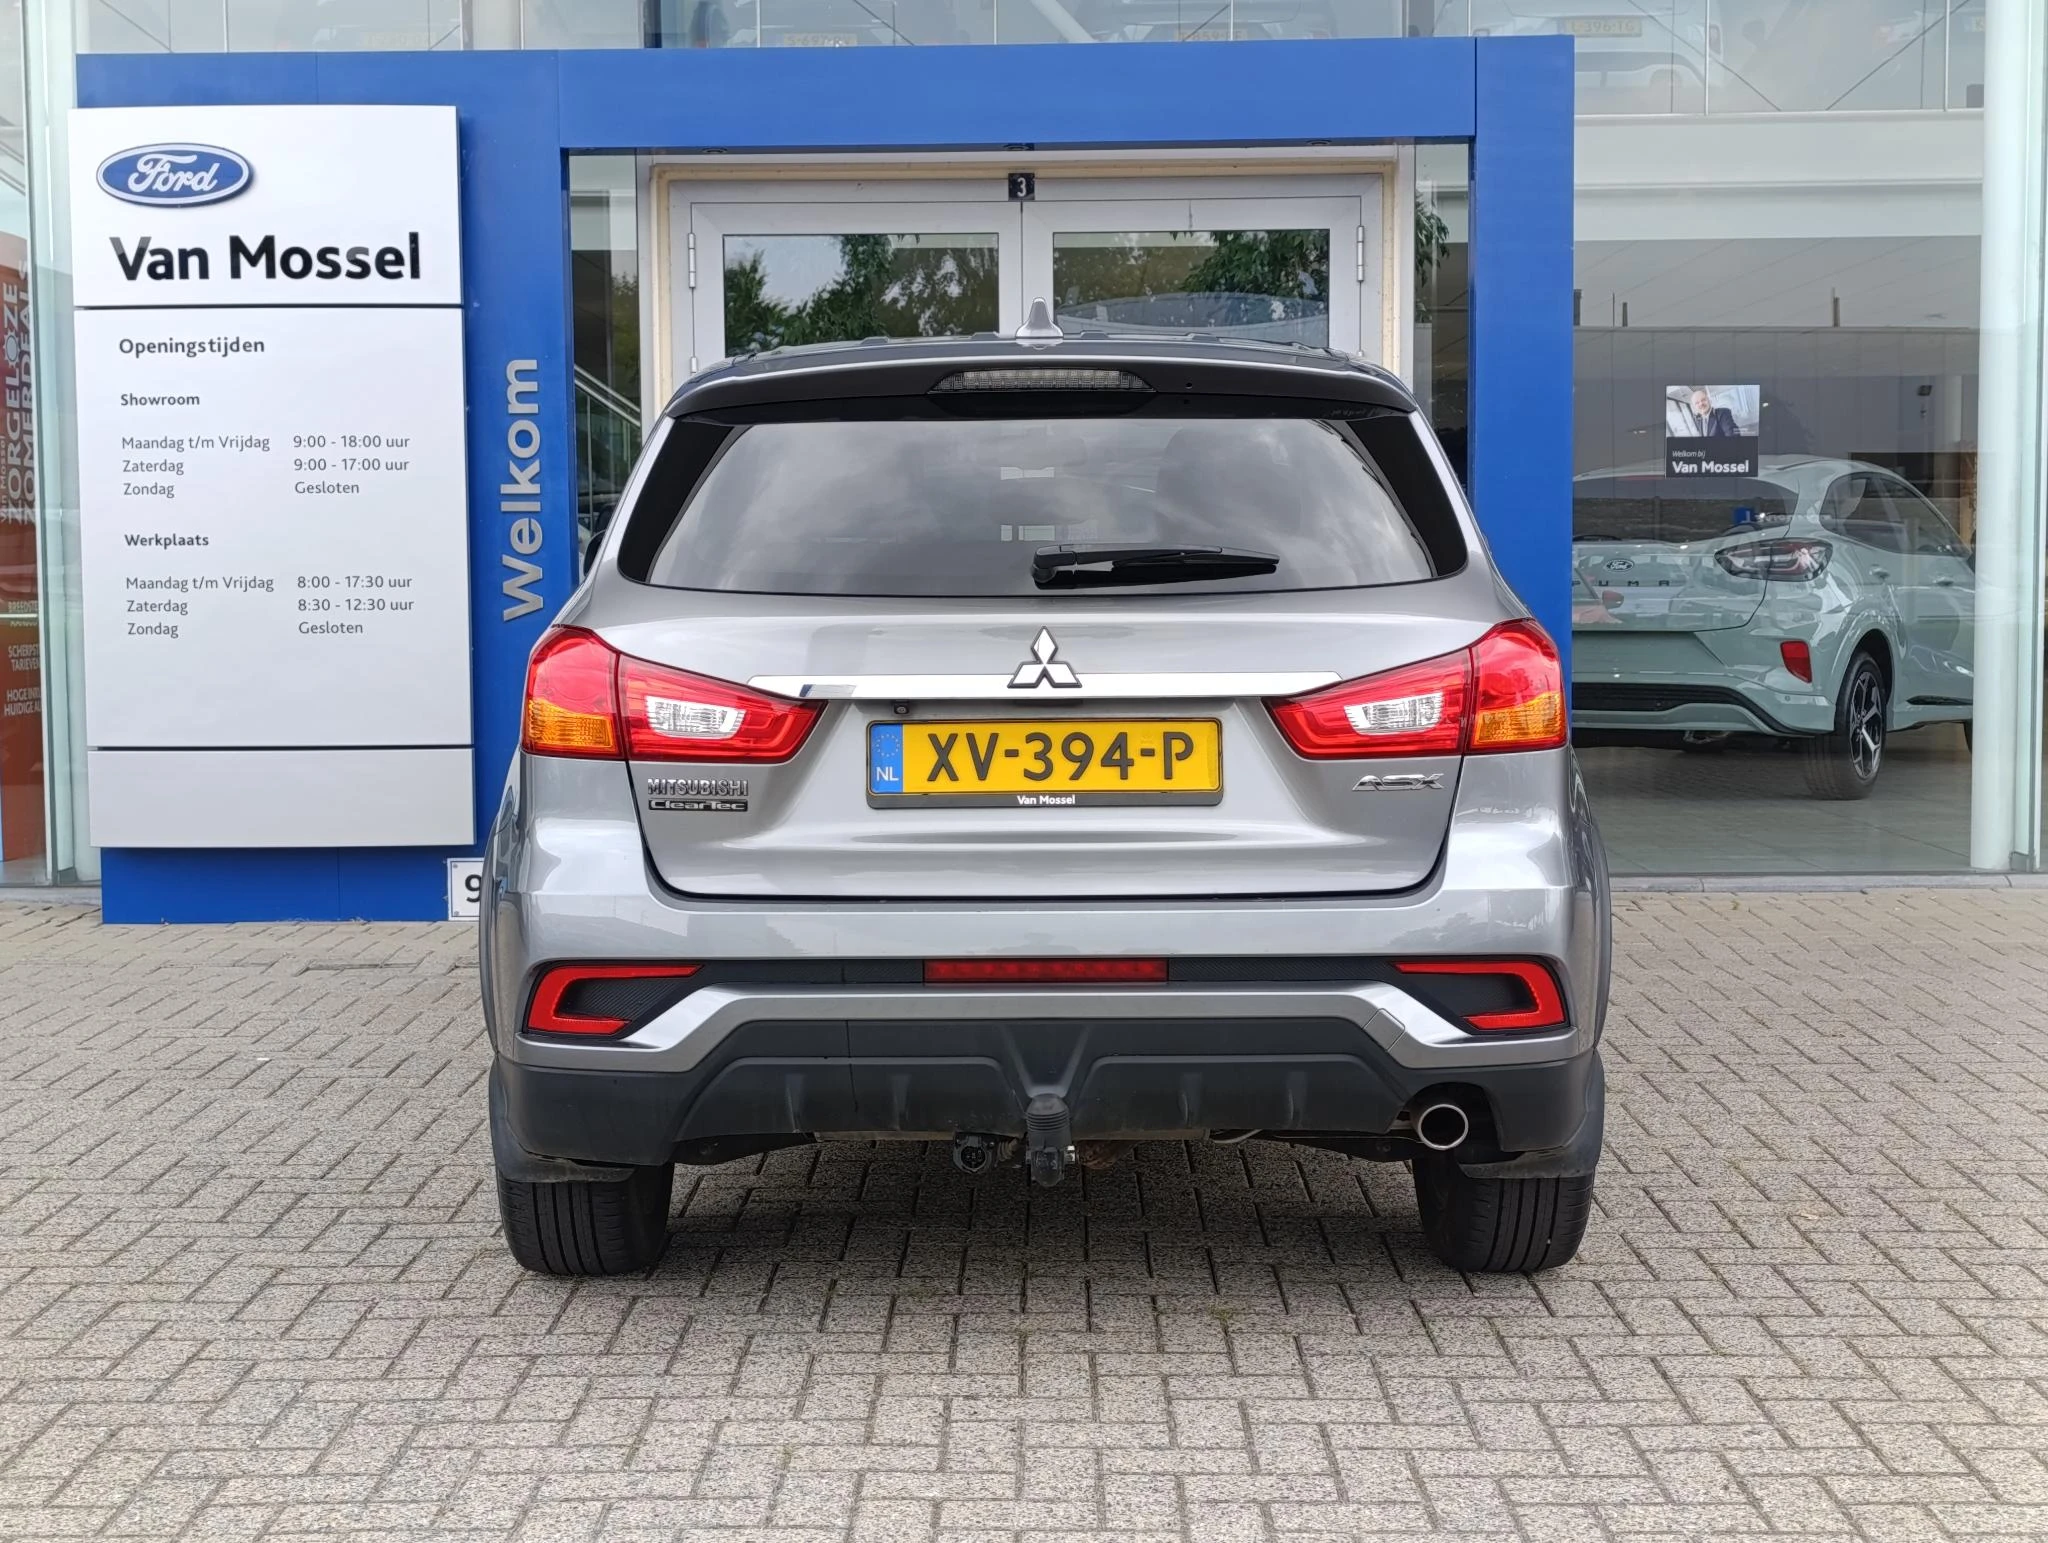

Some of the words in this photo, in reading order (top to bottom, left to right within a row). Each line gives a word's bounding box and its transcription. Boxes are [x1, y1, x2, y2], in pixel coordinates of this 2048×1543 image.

[128, 152, 219, 193] Ford
[1017, 177, 1027, 197] 3
[110, 236, 209, 281] Van
[229, 231, 421, 280] Mossel
[118, 335, 266, 359] Openingstijden
[120, 392, 201, 407] Showroom
[121, 435, 185, 453] Maandag
[188, 435, 215, 449] t/m
[218, 434, 271, 453] Vrijdag
[292, 434, 327, 448] 9:00
[340, 434, 382, 448] 18:00
[385, 438, 411, 448] uur
[1672, 450, 1697, 458] Welkom
[122, 458, 185, 476] Zaterdag
[293, 458, 327, 472] 9:00
[341, 457, 381, 471] 17:00
[385, 461, 410, 471] uur
[1672, 460, 1698, 473] Van
[1701, 459, 1749, 473] Mossel
[123, 481, 175, 499] Zondag
[294, 480, 360, 494] Gesloten
[500, 359, 544, 621] Welkom
[123, 532, 210, 551] Werkplaats
[126, 575, 189, 594] Maandag
[191, 575, 219, 590] t/m
[222, 575, 275, 593] Vrijdag
[297, 575, 331, 589] 8:00
[344, 575, 384, 589] 17:30
[388, 578, 413, 588] uur
[126, 599, 189, 616] Zaterdag
[297, 598, 331, 612] 8:30
[344, 598, 386, 611] 12:30
[390, 601, 415, 611] uur
[127, 621, 179, 640] Zondag
[298, 620, 364, 635] Gesloten
[926, 731, 1195, 782] XV-394-P
[876, 767, 899, 782] NL
[1352, 773, 1444, 792] ASX
[647, 778, 748, 796] MITSUBISHI
[650, 799, 746, 811] ClearTec
[1017, 795, 1037, 805] Van
[1039, 794, 1076, 805] Mossel
